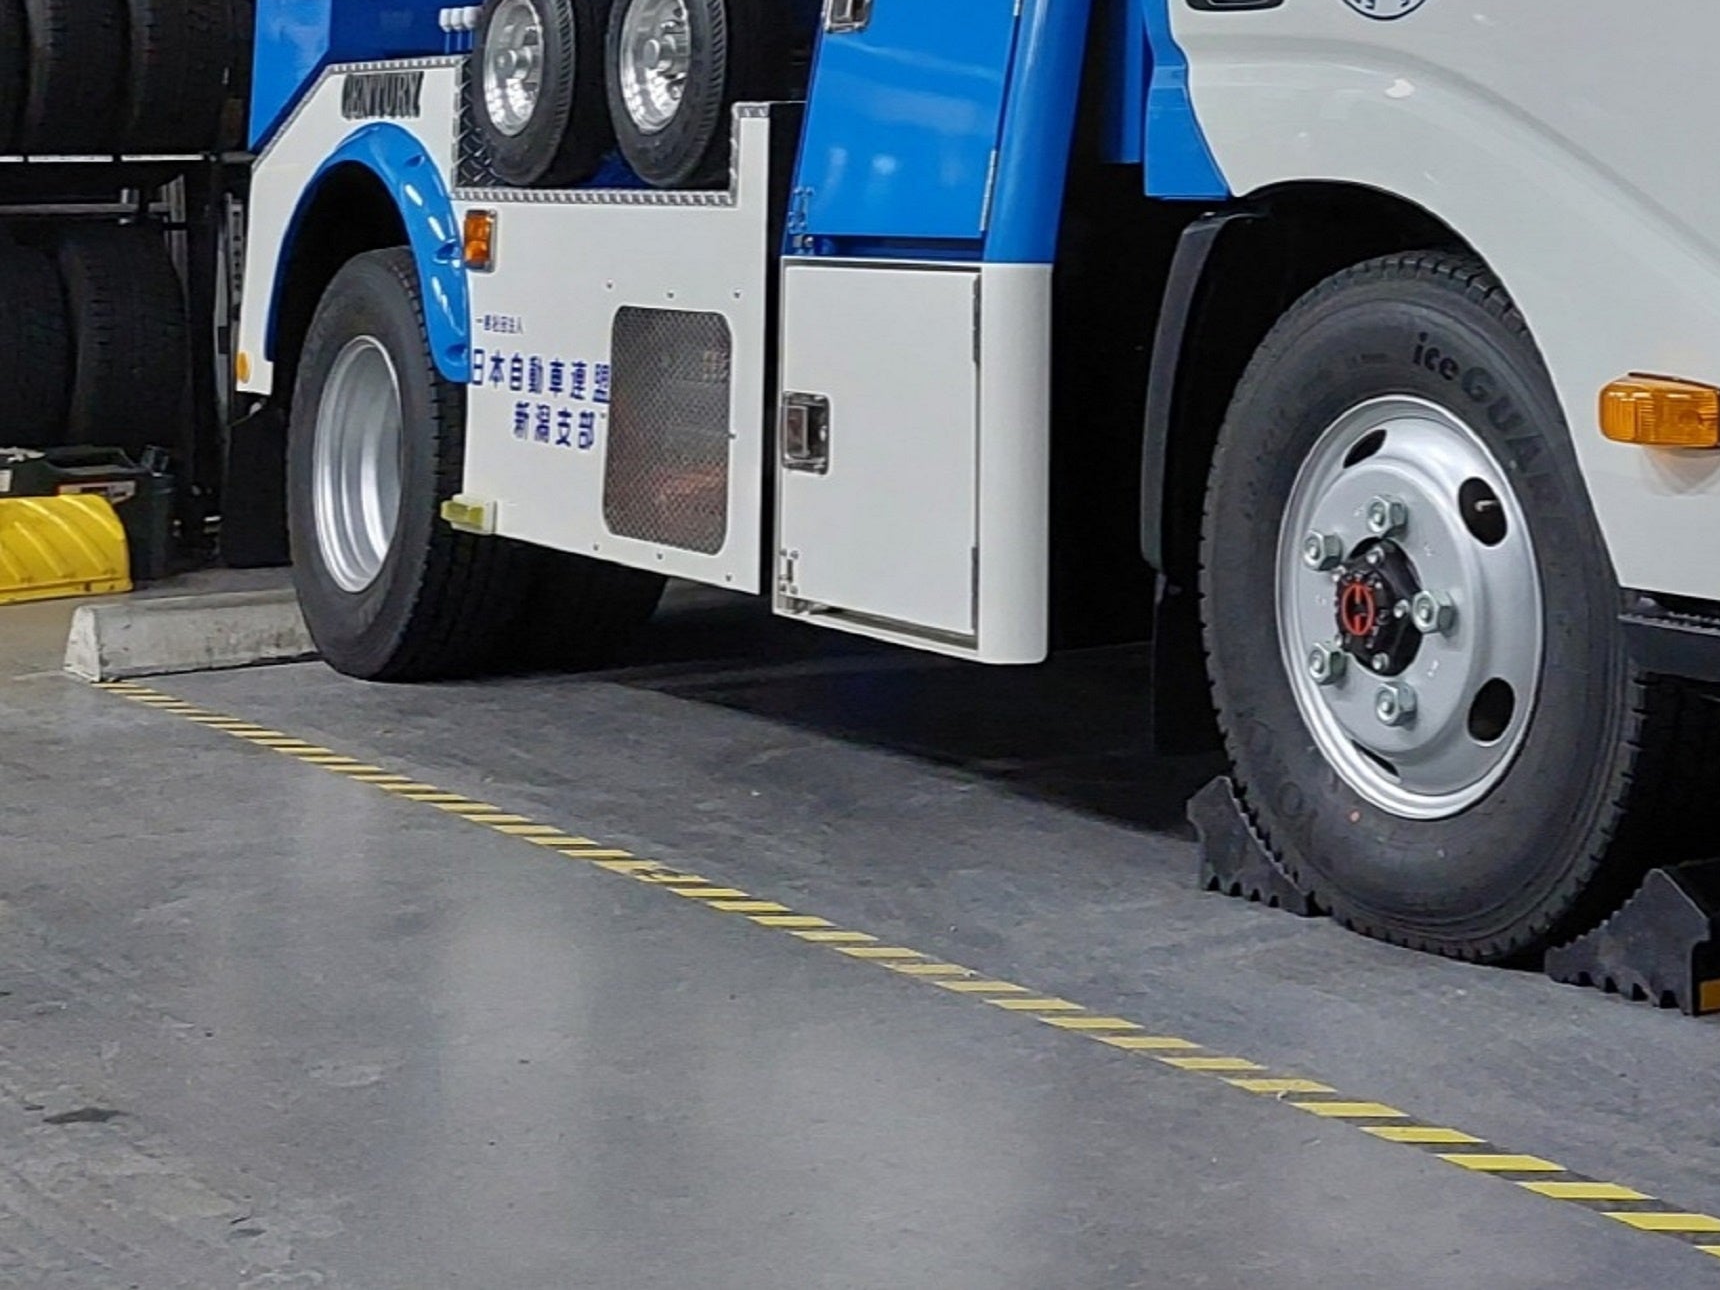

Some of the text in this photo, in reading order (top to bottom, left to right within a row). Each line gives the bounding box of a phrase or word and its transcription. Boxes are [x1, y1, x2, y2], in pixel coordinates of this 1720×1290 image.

[472, 348, 611, 405] 日本自動車連盟
